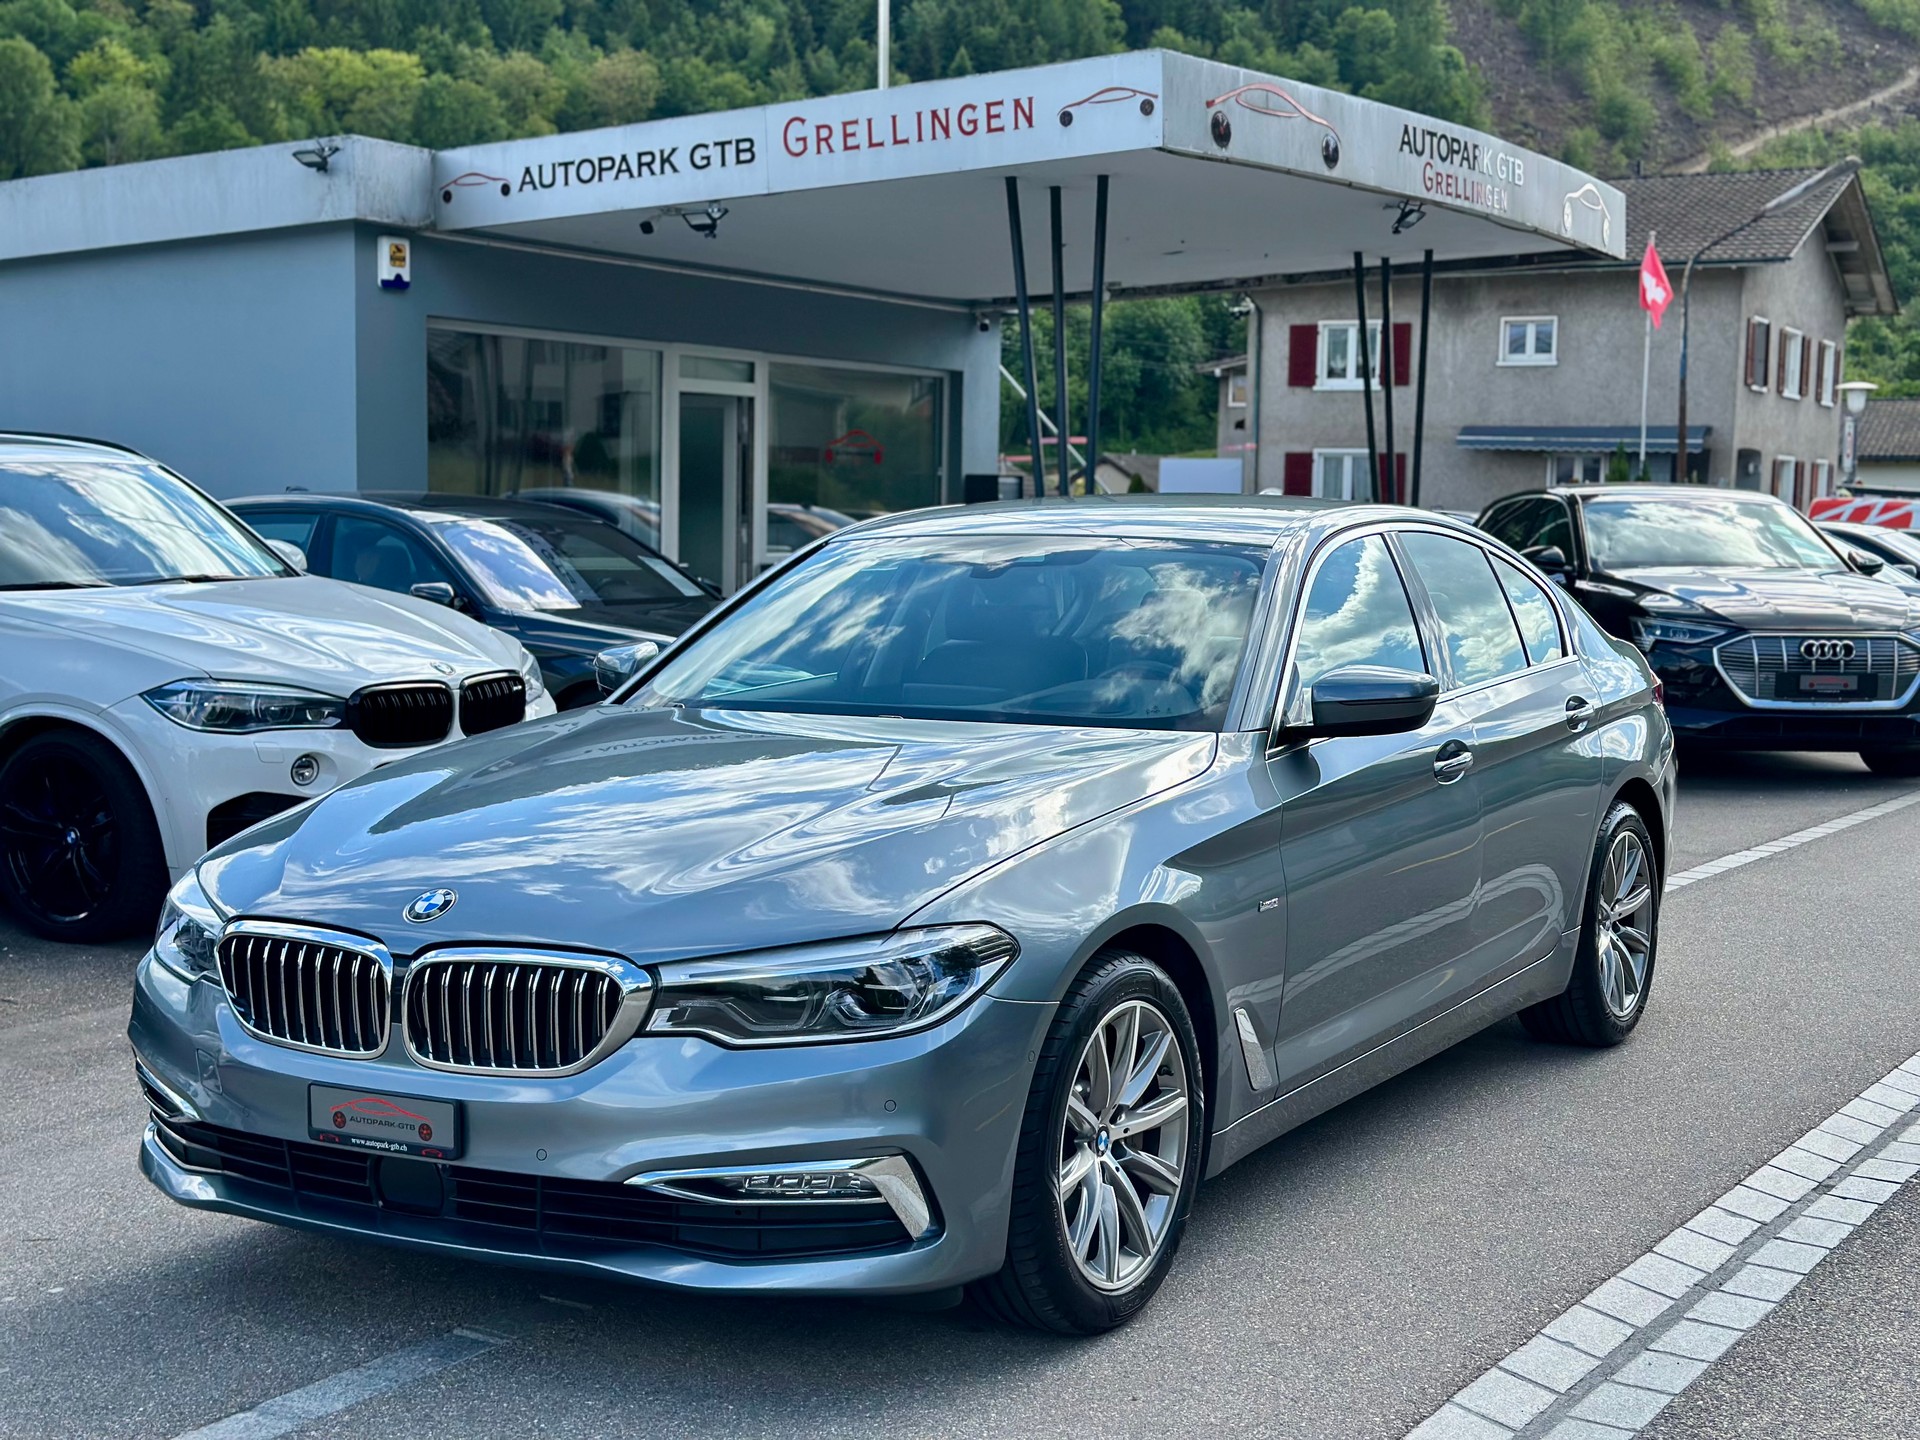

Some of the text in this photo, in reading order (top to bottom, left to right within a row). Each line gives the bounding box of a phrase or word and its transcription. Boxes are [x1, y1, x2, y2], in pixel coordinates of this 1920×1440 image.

[518, 96, 1035, 192] AUTOPARK GTB GRELLINGEN
[1399, 124, 1524, 186] AUTOPARK GTB
[1423, 161, 1508, 213] GRELLINGEN
[349, 1116, 416, 1131] AUTOPARK-GTB
[351, 1137, 408, 1152] www.autopark-gtb.ch
